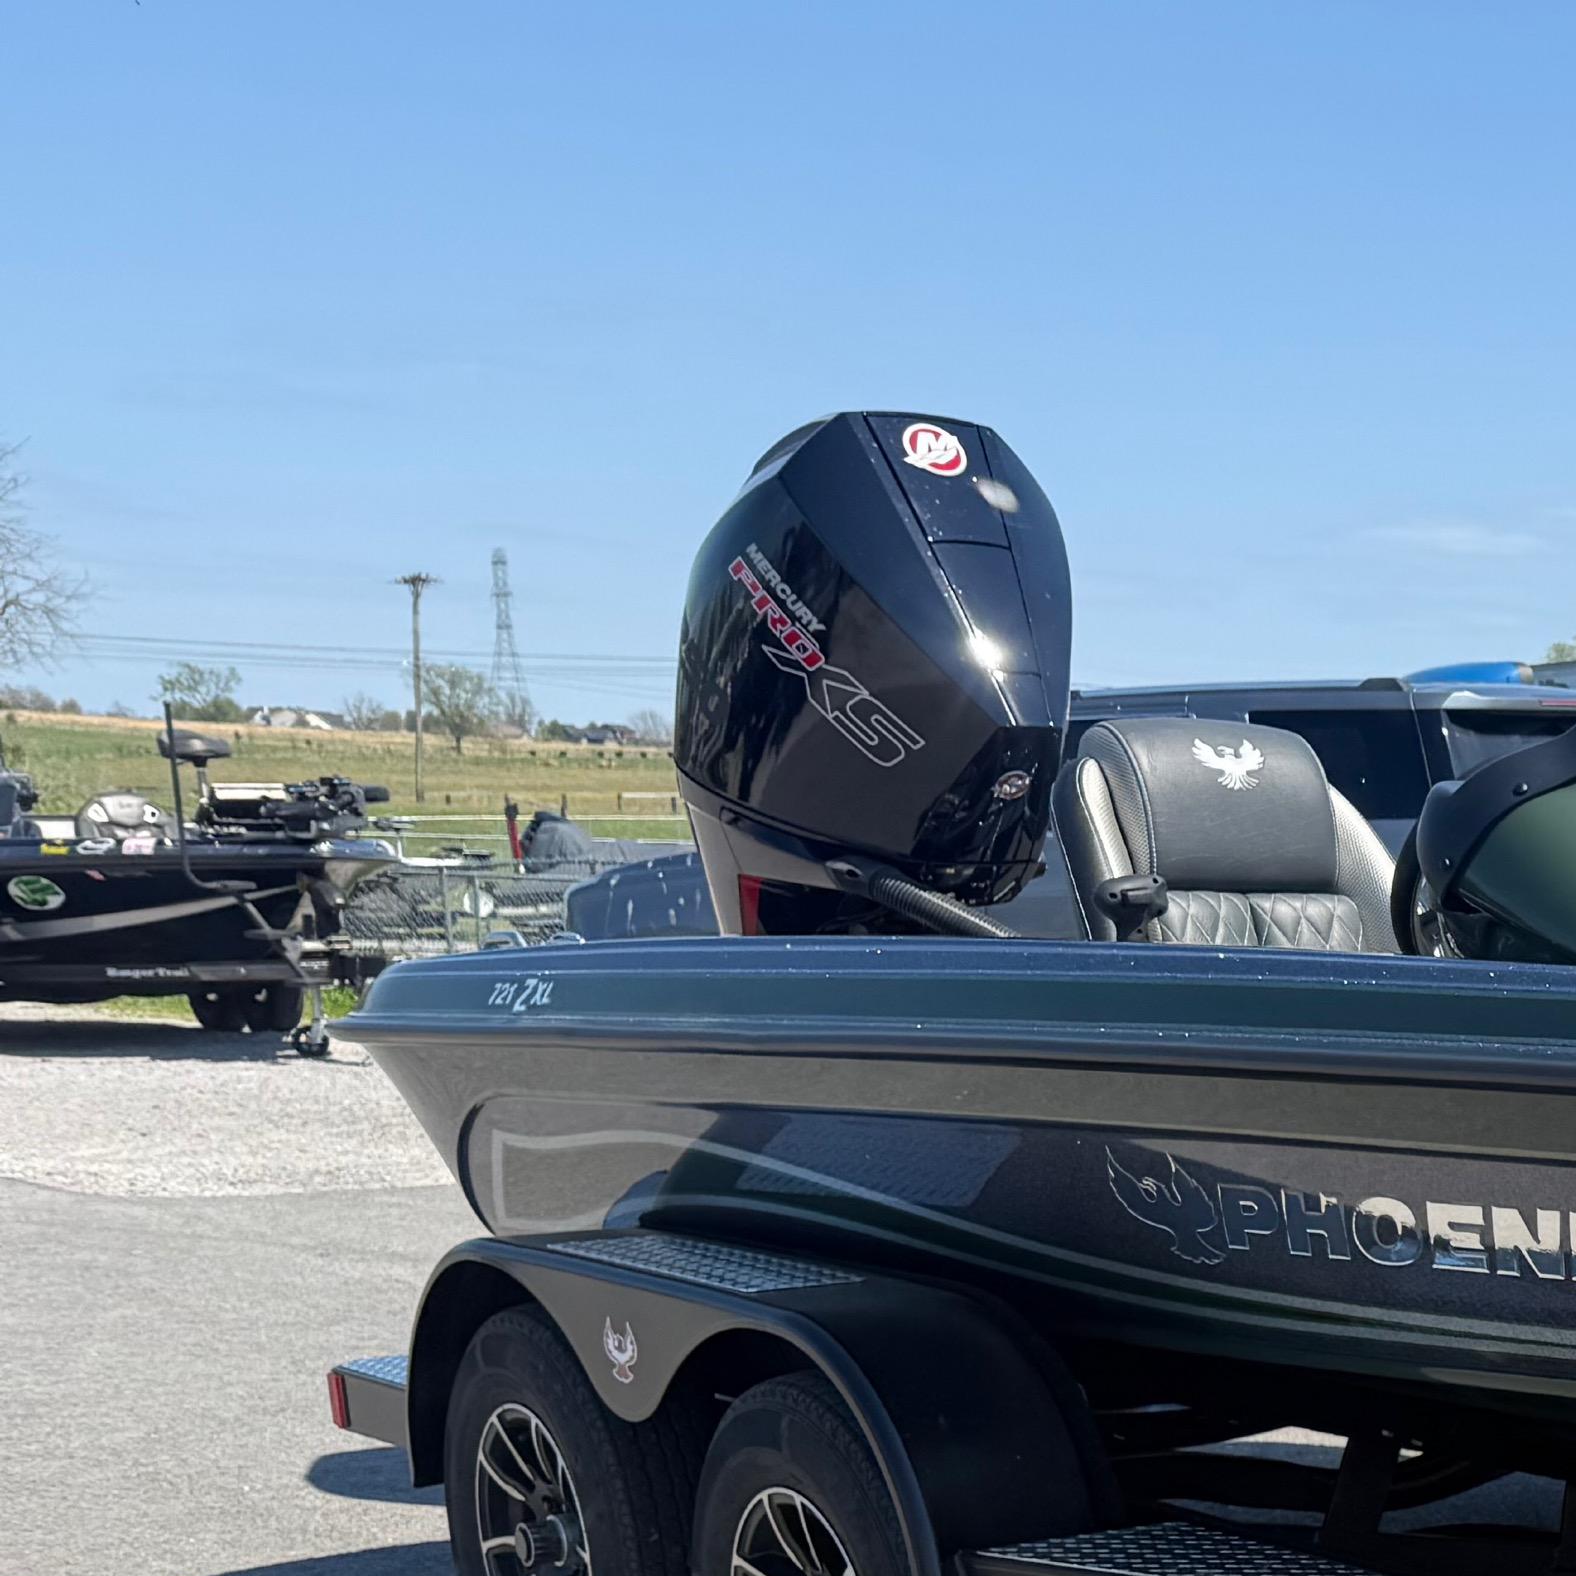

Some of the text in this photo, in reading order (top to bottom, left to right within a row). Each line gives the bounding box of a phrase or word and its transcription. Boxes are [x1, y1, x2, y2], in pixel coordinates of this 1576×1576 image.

[728, 557, 825, 671] PRO
[747, 543, 826, 633] MERCURY
[762, 622, 925, 767] XS
[488, 982, 518, 1005] 721
